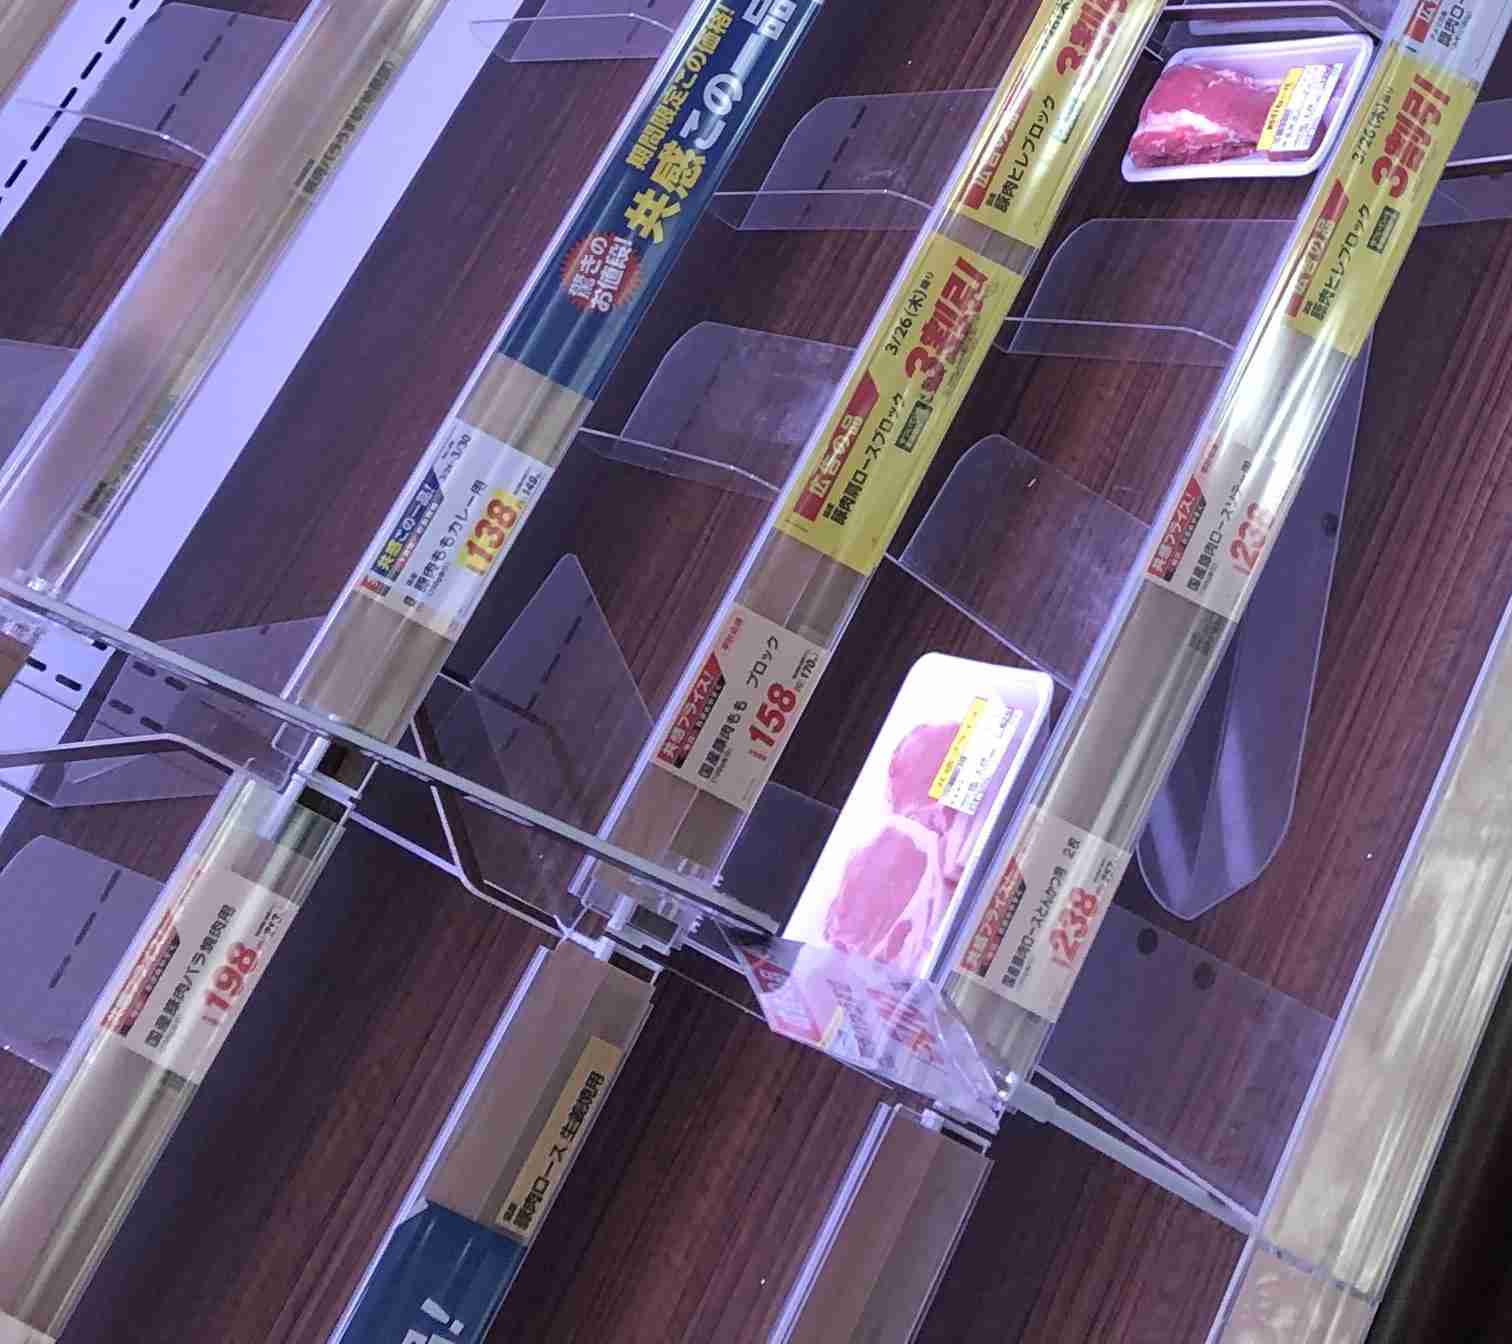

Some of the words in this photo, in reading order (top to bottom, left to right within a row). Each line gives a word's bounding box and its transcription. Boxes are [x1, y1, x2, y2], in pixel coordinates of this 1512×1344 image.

[624, 1, 736, 172] 期間限定この価格!
[992, 93, 1059, 213] 豚肉ヒレブロック
[1366, 73, 1453, 200] 3割引
[895, 255, 998, 396] 3割引
[828, 391, 910, 526] 豚肉肩ロースブロック
[462, 495, 521, 566] 138
[744, 634, 782, 690] ブロック
[743, 679, 801, 750] 158
[1046, 883, 1103, 959] 238
[197, 937, 261, 1016] 198
